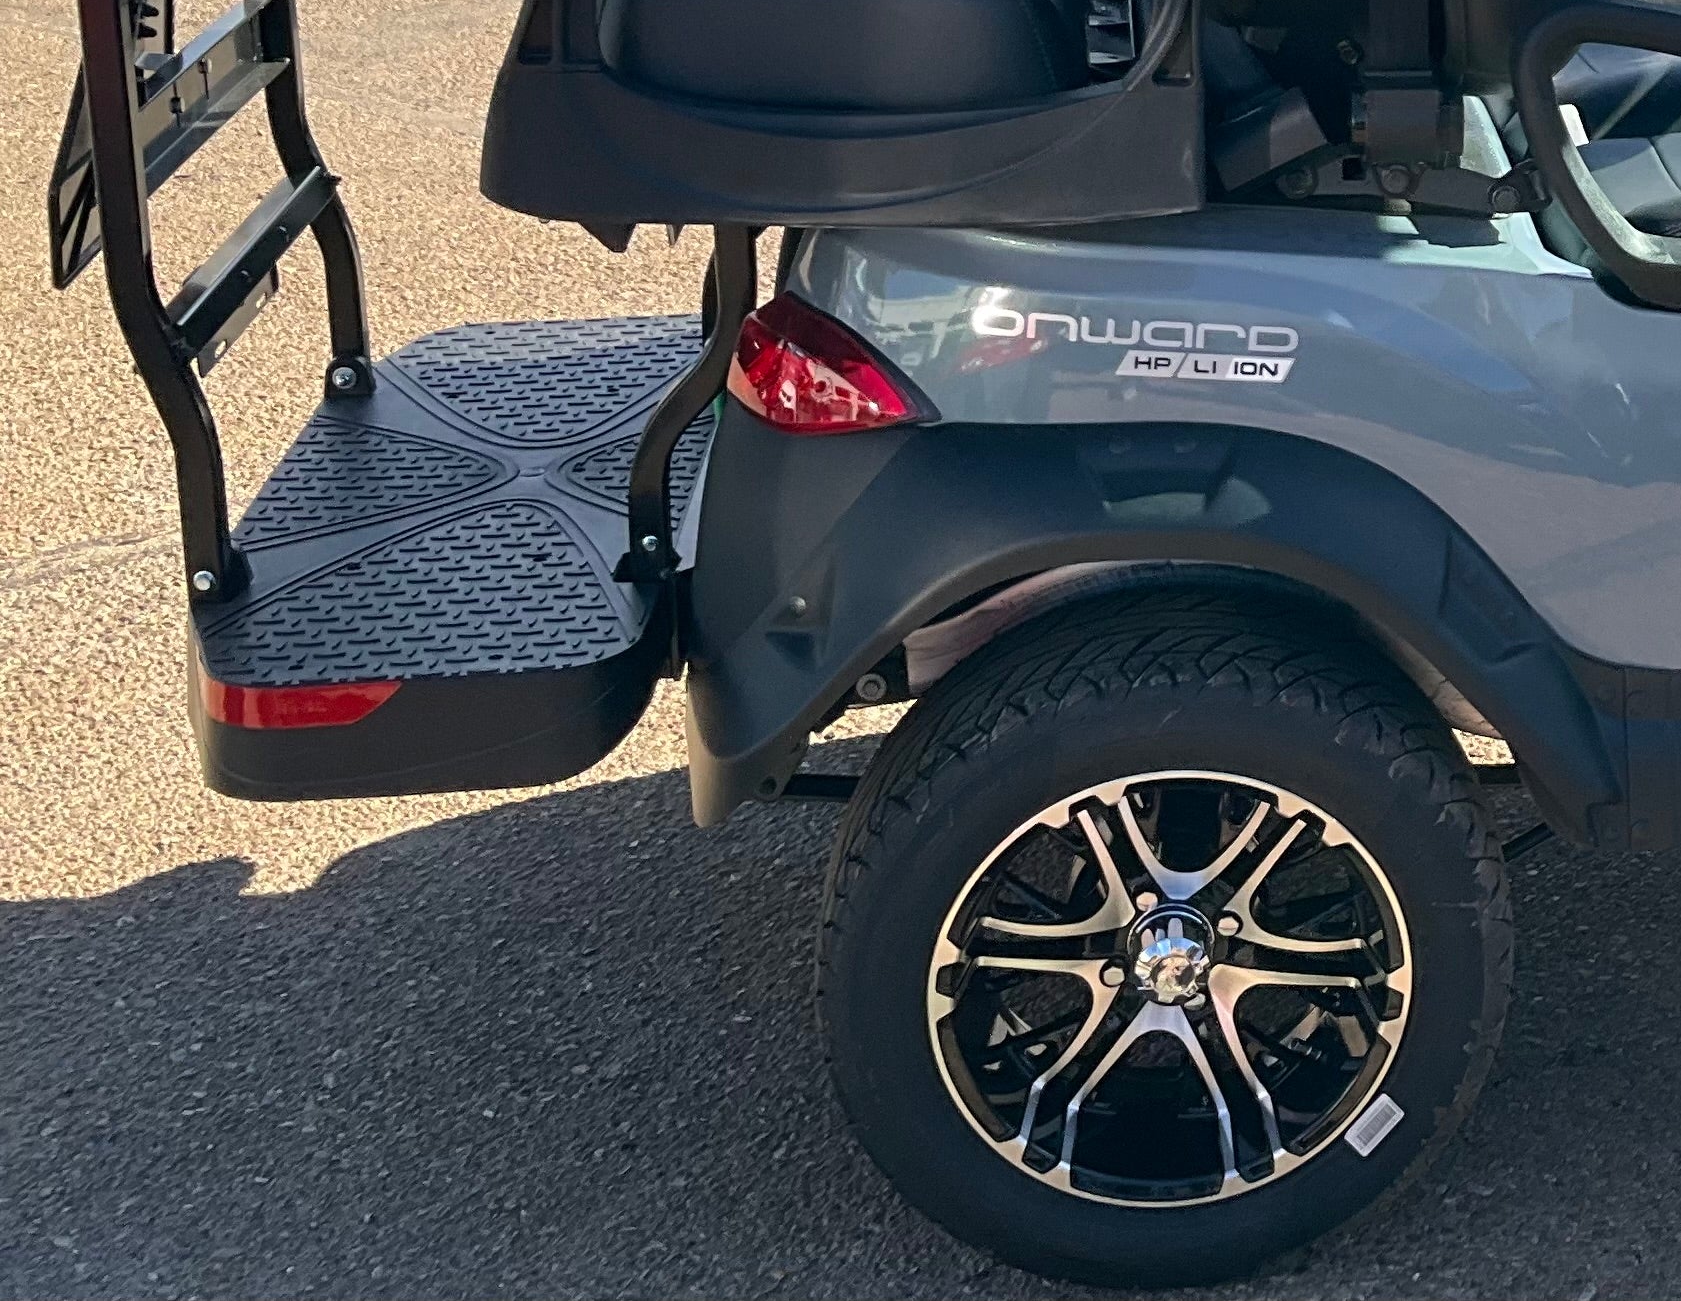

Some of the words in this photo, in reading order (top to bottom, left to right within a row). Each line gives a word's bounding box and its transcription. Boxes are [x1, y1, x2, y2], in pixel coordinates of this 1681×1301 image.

[1134, 356, 1171, 371] HP
[1194, 359, 1217, 374] LI
[1233, 361, 1279, 376] ION
